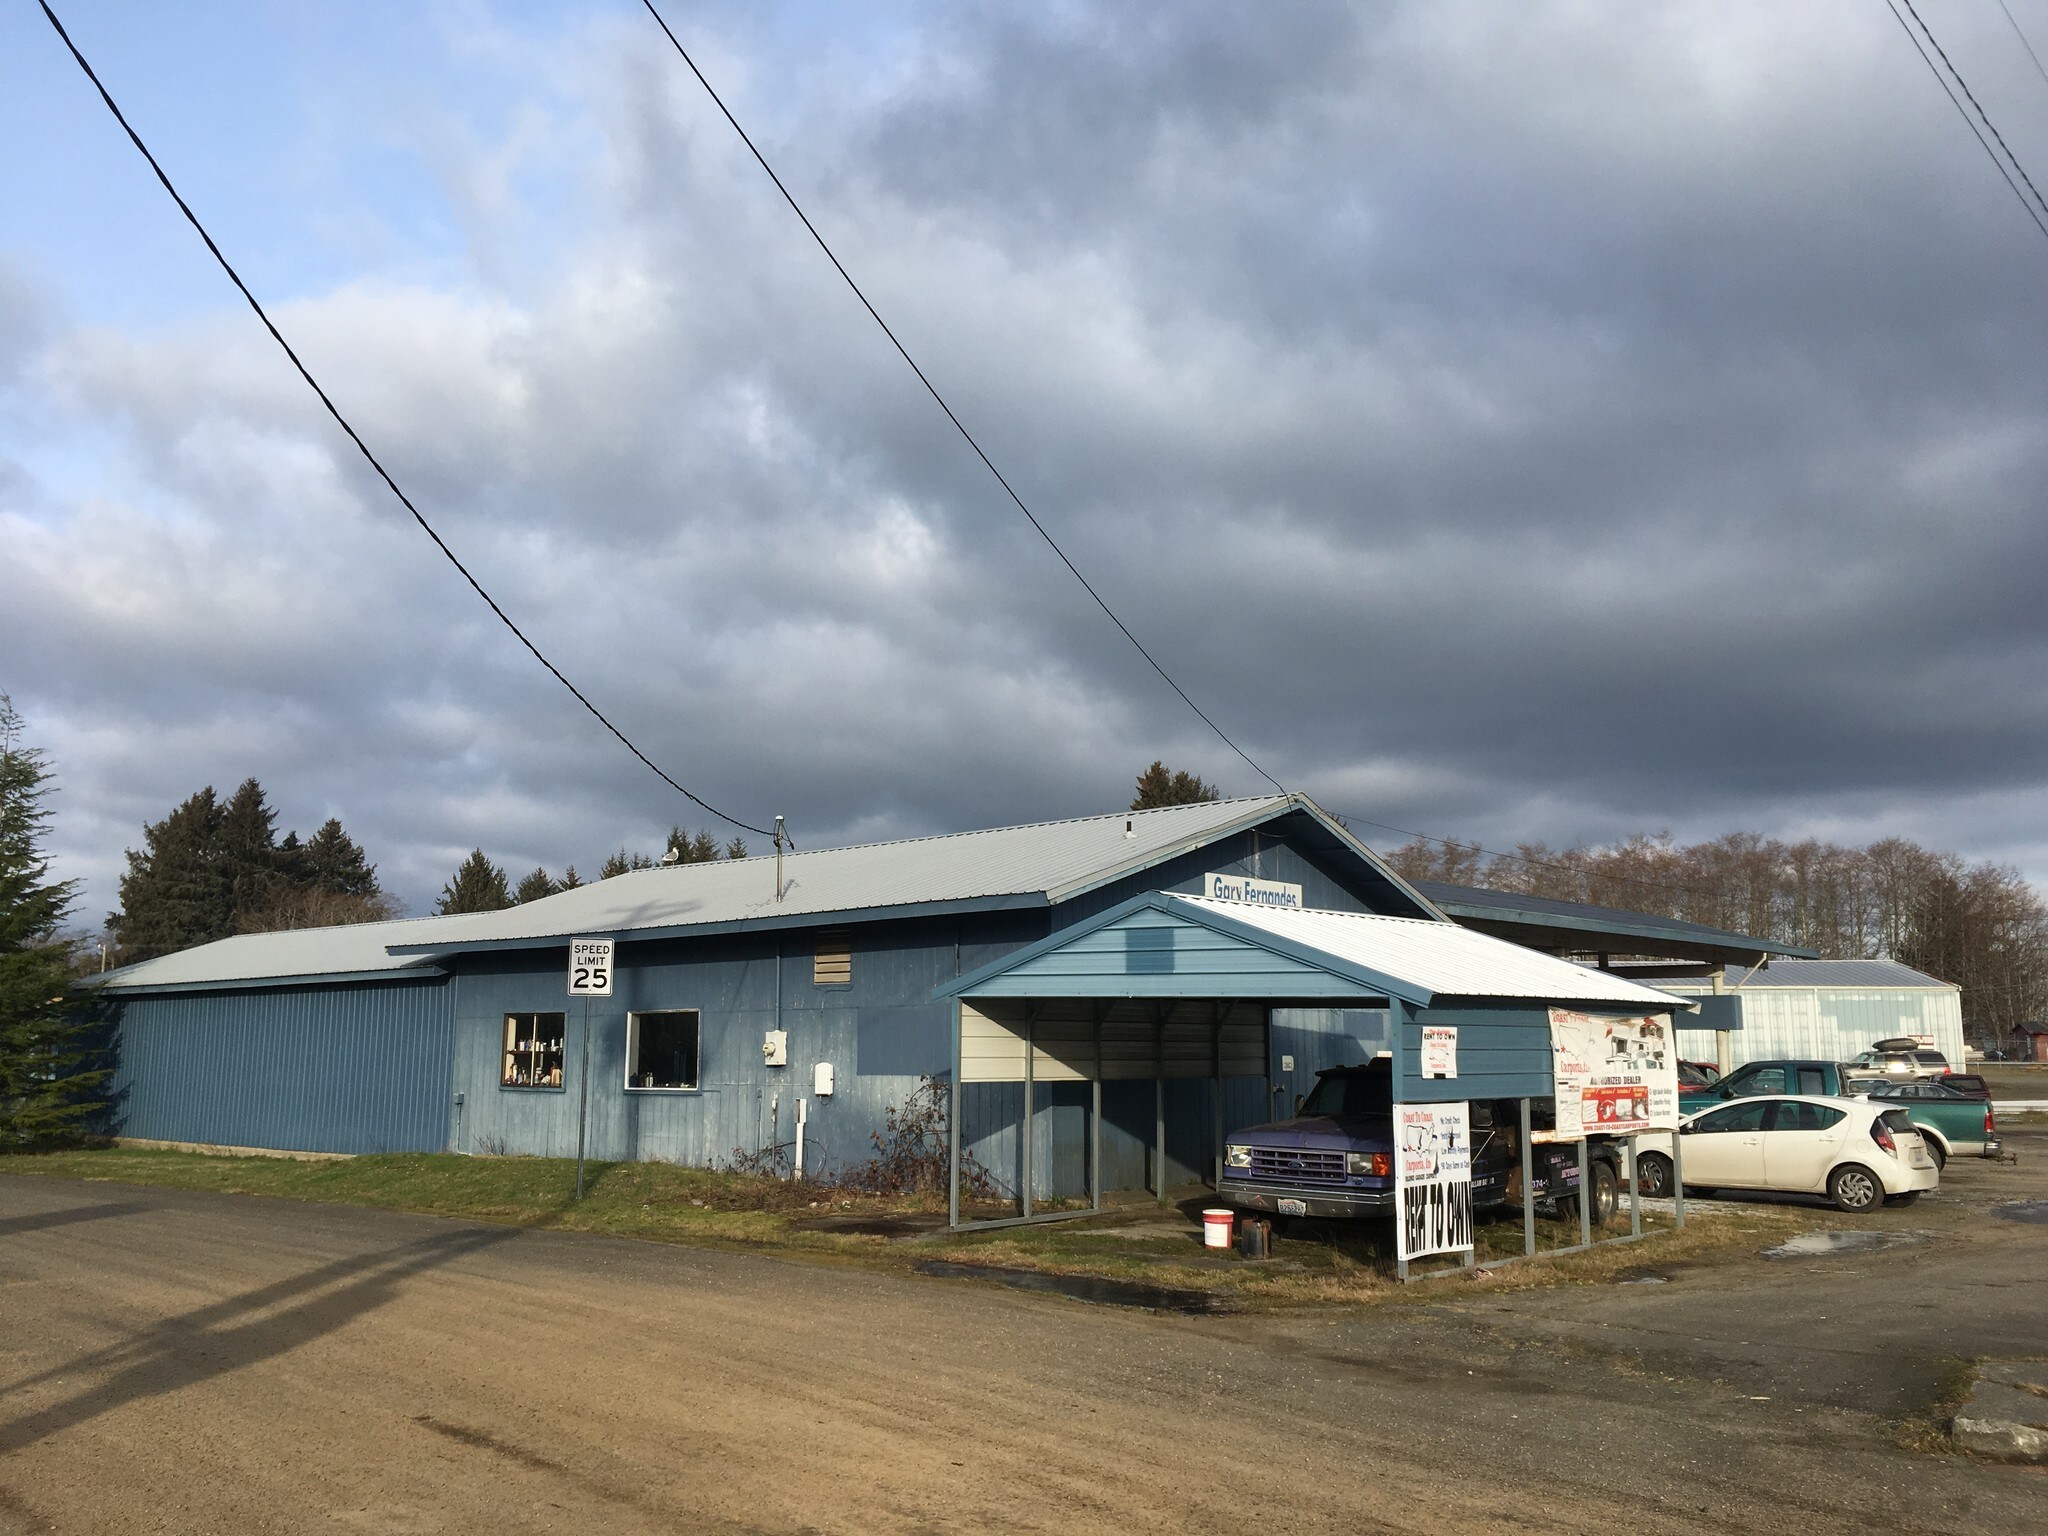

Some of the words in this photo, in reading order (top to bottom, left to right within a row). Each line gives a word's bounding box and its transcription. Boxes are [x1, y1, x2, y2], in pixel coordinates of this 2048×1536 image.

[1213, 876, 1242, 899] Gary
[1244, 881, 1297, 906] Fernandes
[574, 944, 610, 954] SPEED
[577, 956, 606, 966] LIMIT
[573, 967, 608, 989] 25
[1590, 1076, 1622, 1085] AUHORIZED
[1623, 1075, 1642, 1084] DEALER
[1404, 1186, 1428, 1255] RENT
[1430, 1182, 1443, 1249] TO
[1447, 1181, 1473, 1248] OWN
